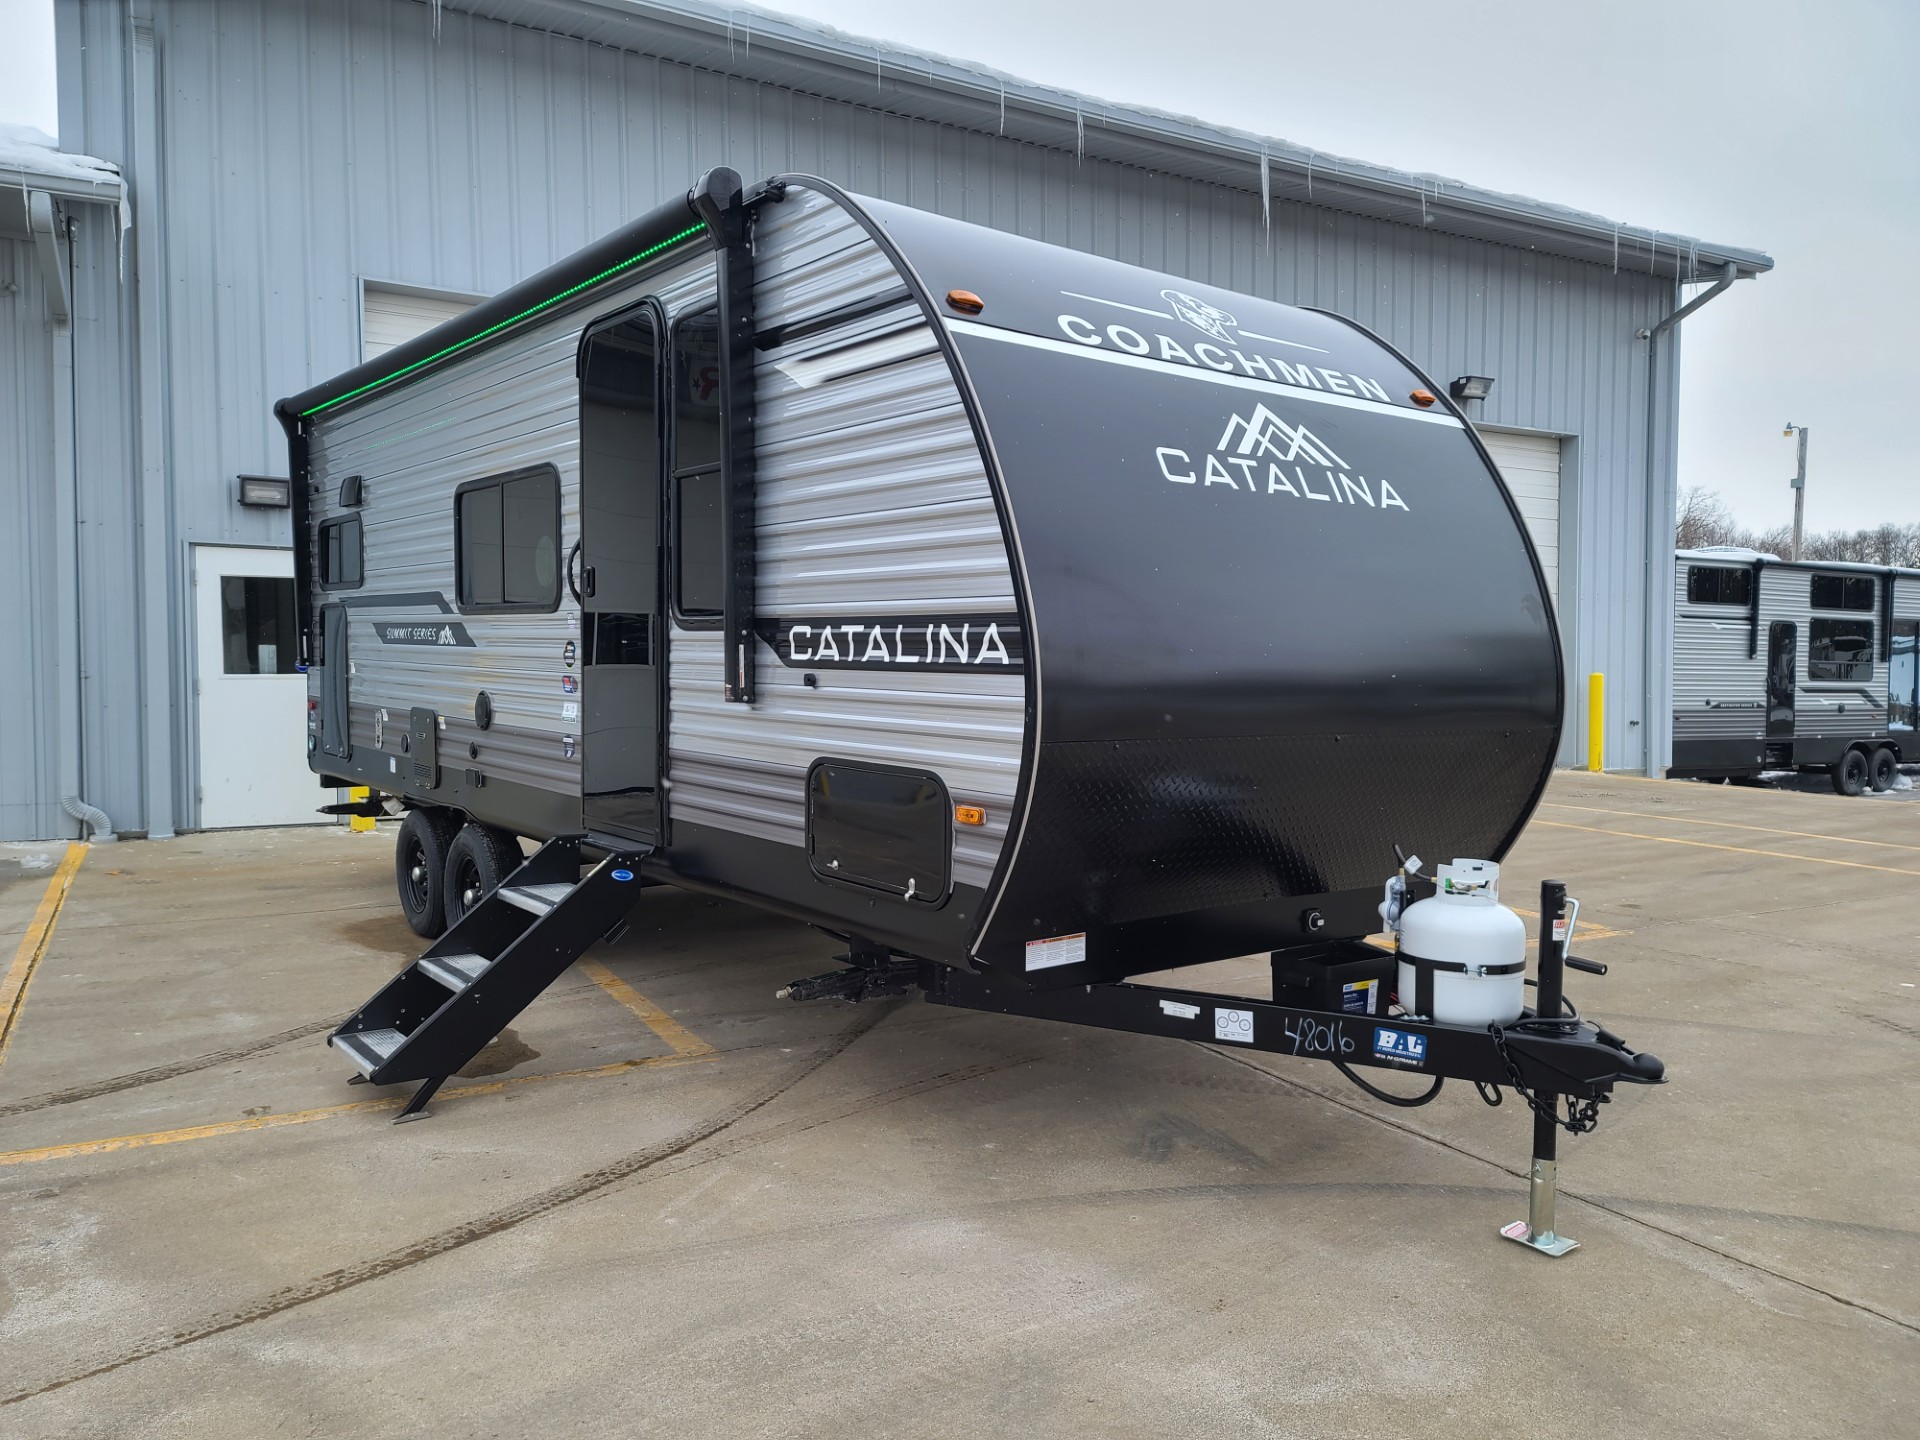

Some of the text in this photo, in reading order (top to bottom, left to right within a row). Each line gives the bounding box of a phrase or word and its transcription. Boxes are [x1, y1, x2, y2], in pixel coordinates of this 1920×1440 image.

[1057, 314, 1391, 402] COACHMEN
[1156, 446, 1410, 511] CATALINA
[386, 627, 436, 640] SUMMIT SERIES
[789, 623, 1009, 665] CATALINA
[1284, 1017, 1355, 1055] 48016
